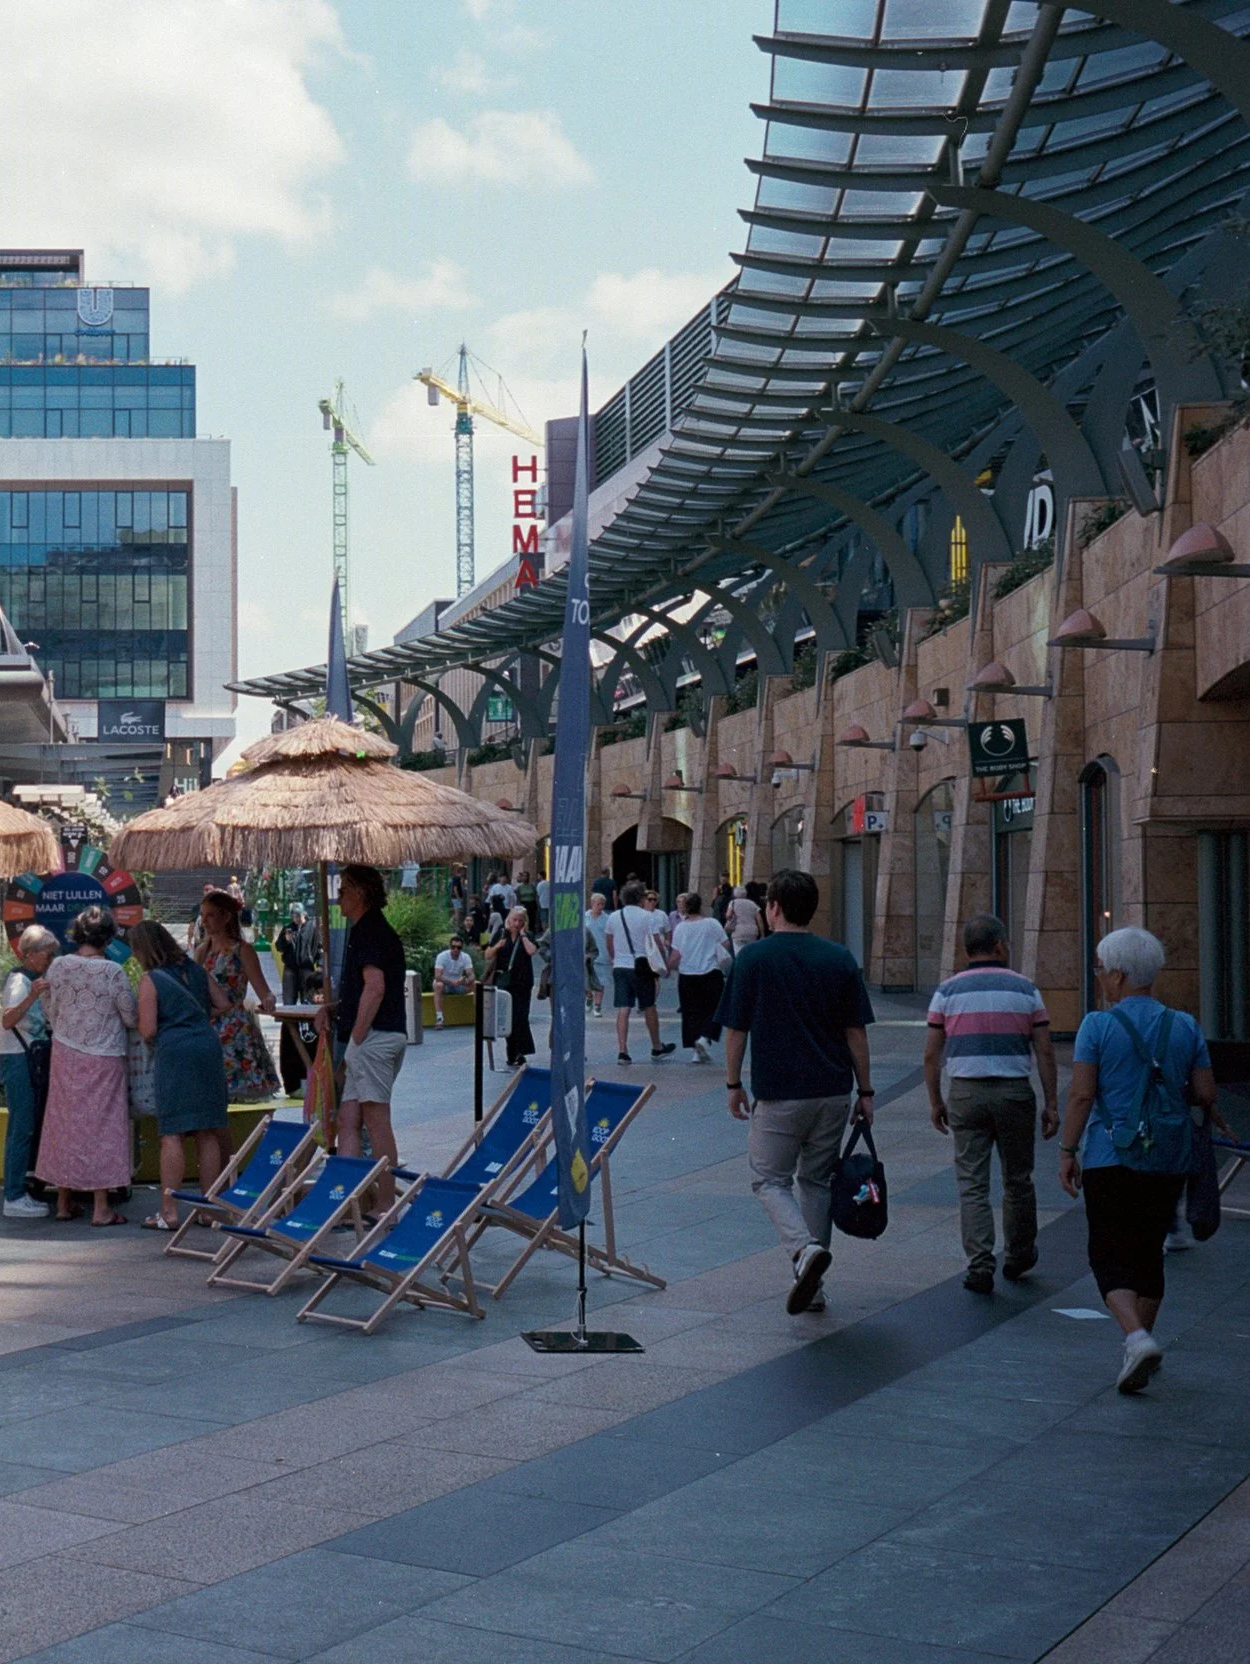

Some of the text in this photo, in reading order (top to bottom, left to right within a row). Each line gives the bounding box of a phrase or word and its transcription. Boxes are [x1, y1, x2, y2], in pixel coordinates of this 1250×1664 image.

[512, 455, 539, 589] HEMA
[103, 725, 160, 736] LACOSTE
[867, 815, 877, 829] P
[42, 890, 102, 900] NIET LULLEN
[35, 903, 65, 913] MAAR
